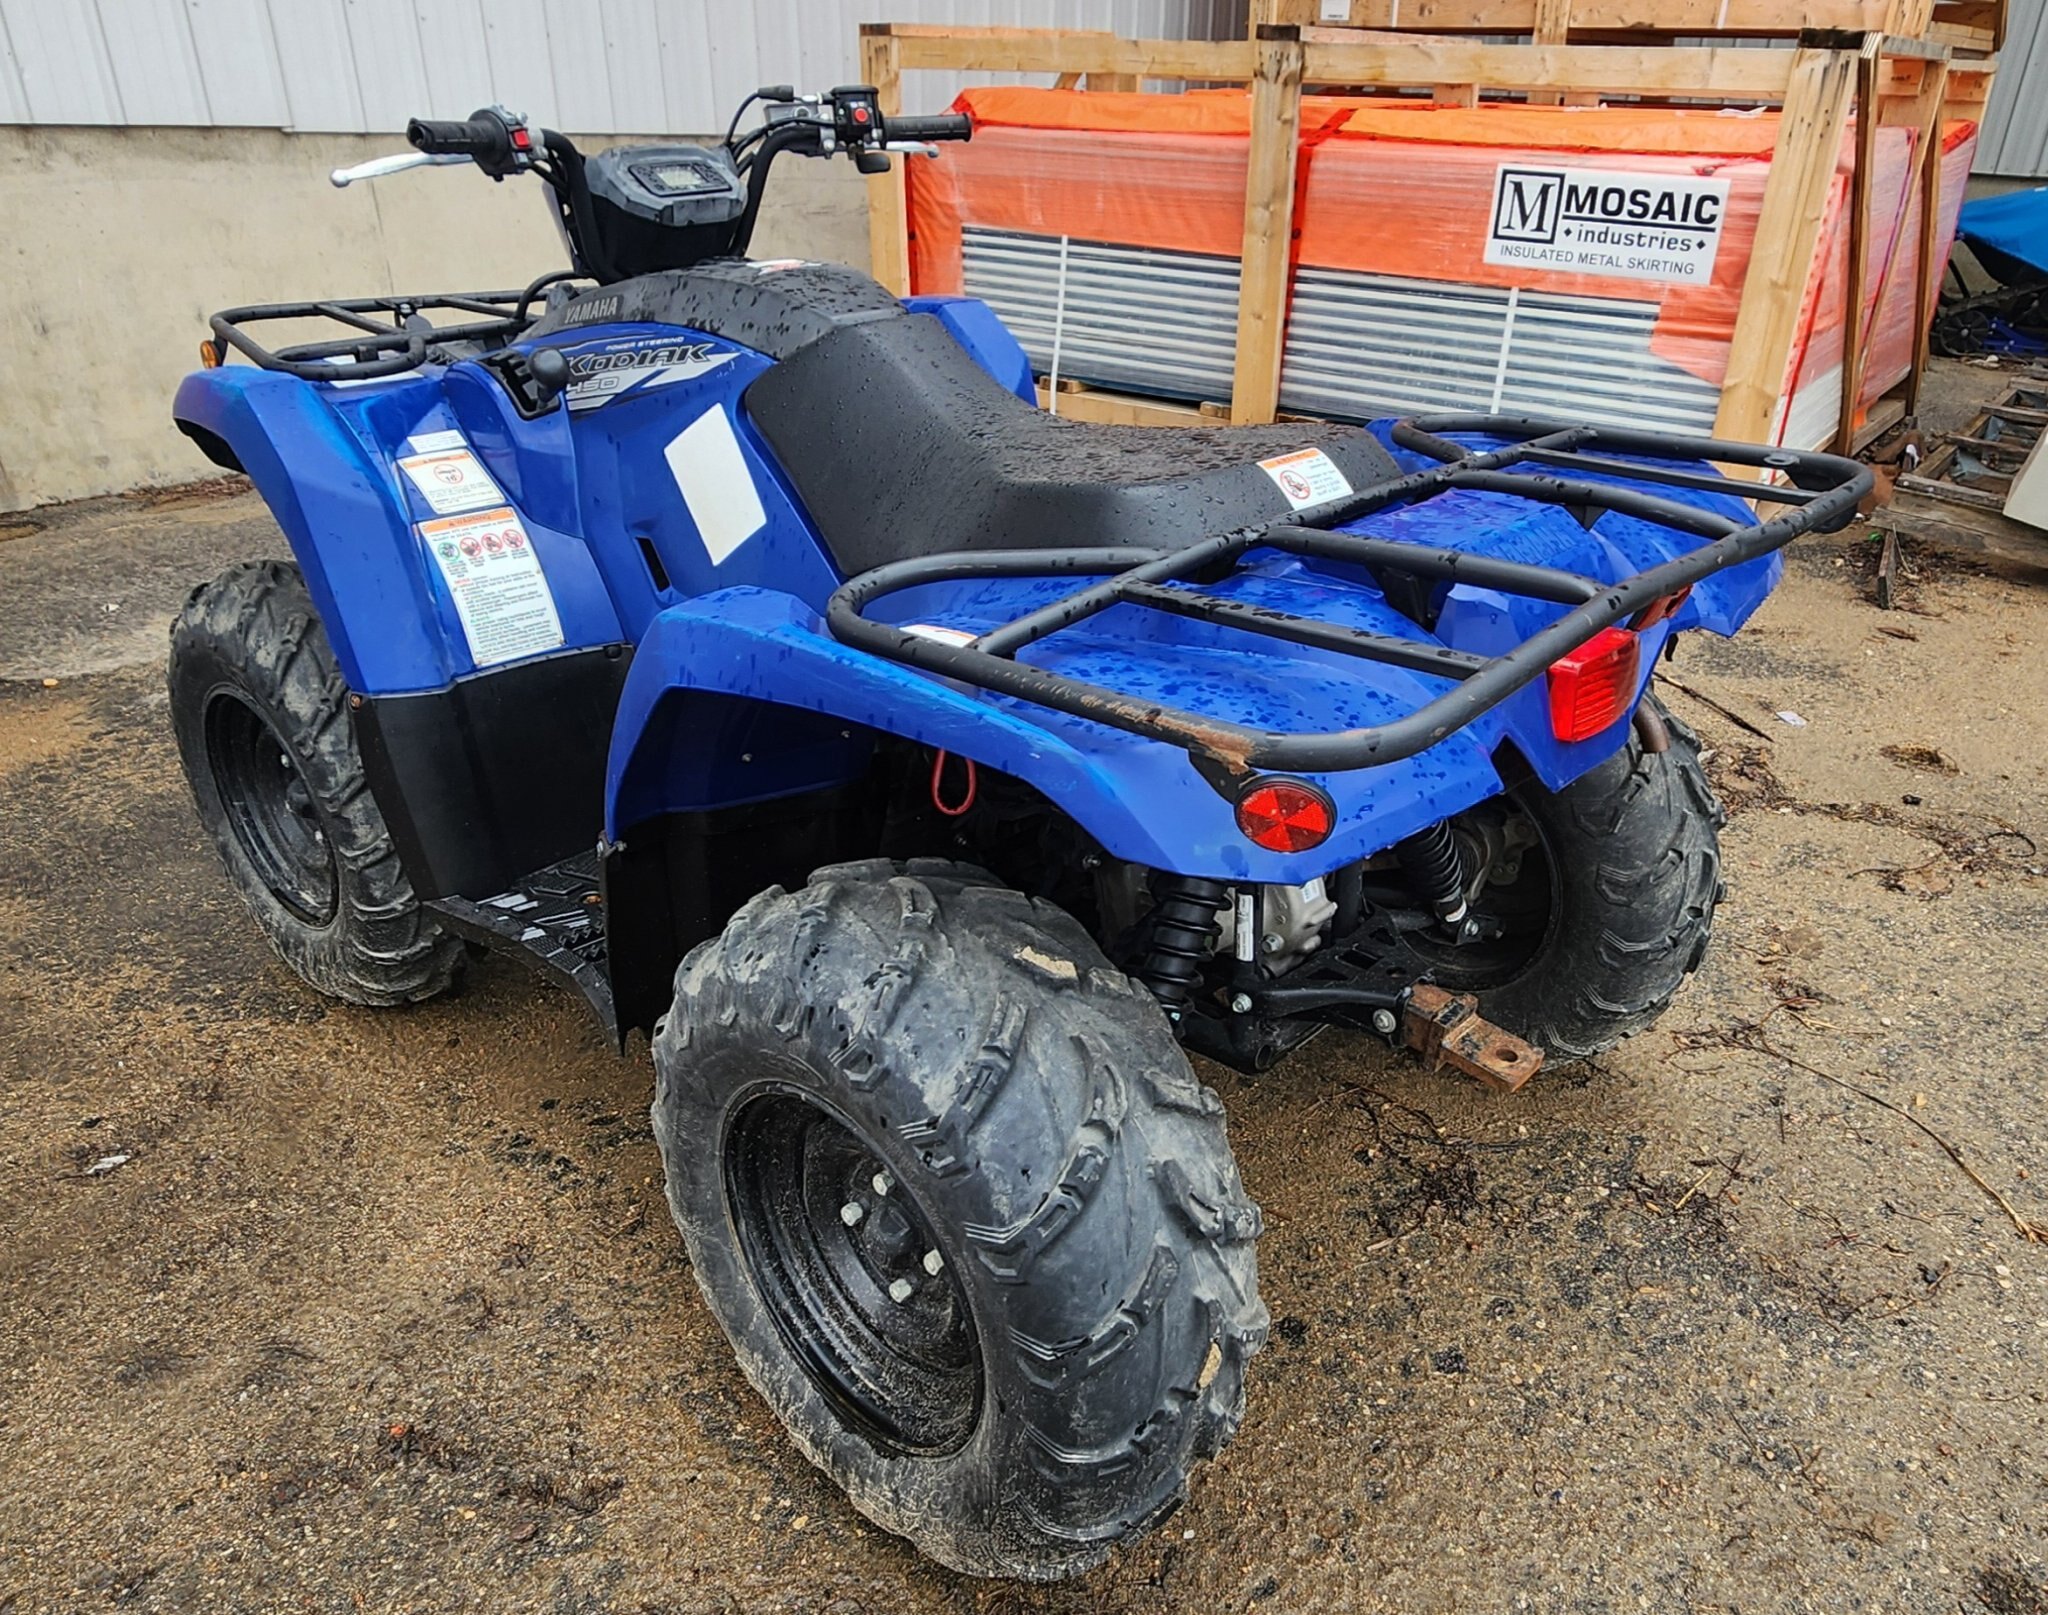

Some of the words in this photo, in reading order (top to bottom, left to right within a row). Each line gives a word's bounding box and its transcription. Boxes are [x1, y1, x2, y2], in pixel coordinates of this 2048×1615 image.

[1502, 180, 1555, 233] M
[1564, 184, 1720, 225] MOSAIC
[1577, 224, 1692, 251] industries
[1500, 245, 1573, 263] INSULATED
[1578, 252, 1623, 268] METAL
[1627, 257, 1695, 275] SKIRTING
[564, 296, 617, 324] YAMAHA
[568, 343, 715, 375] KODIAK
